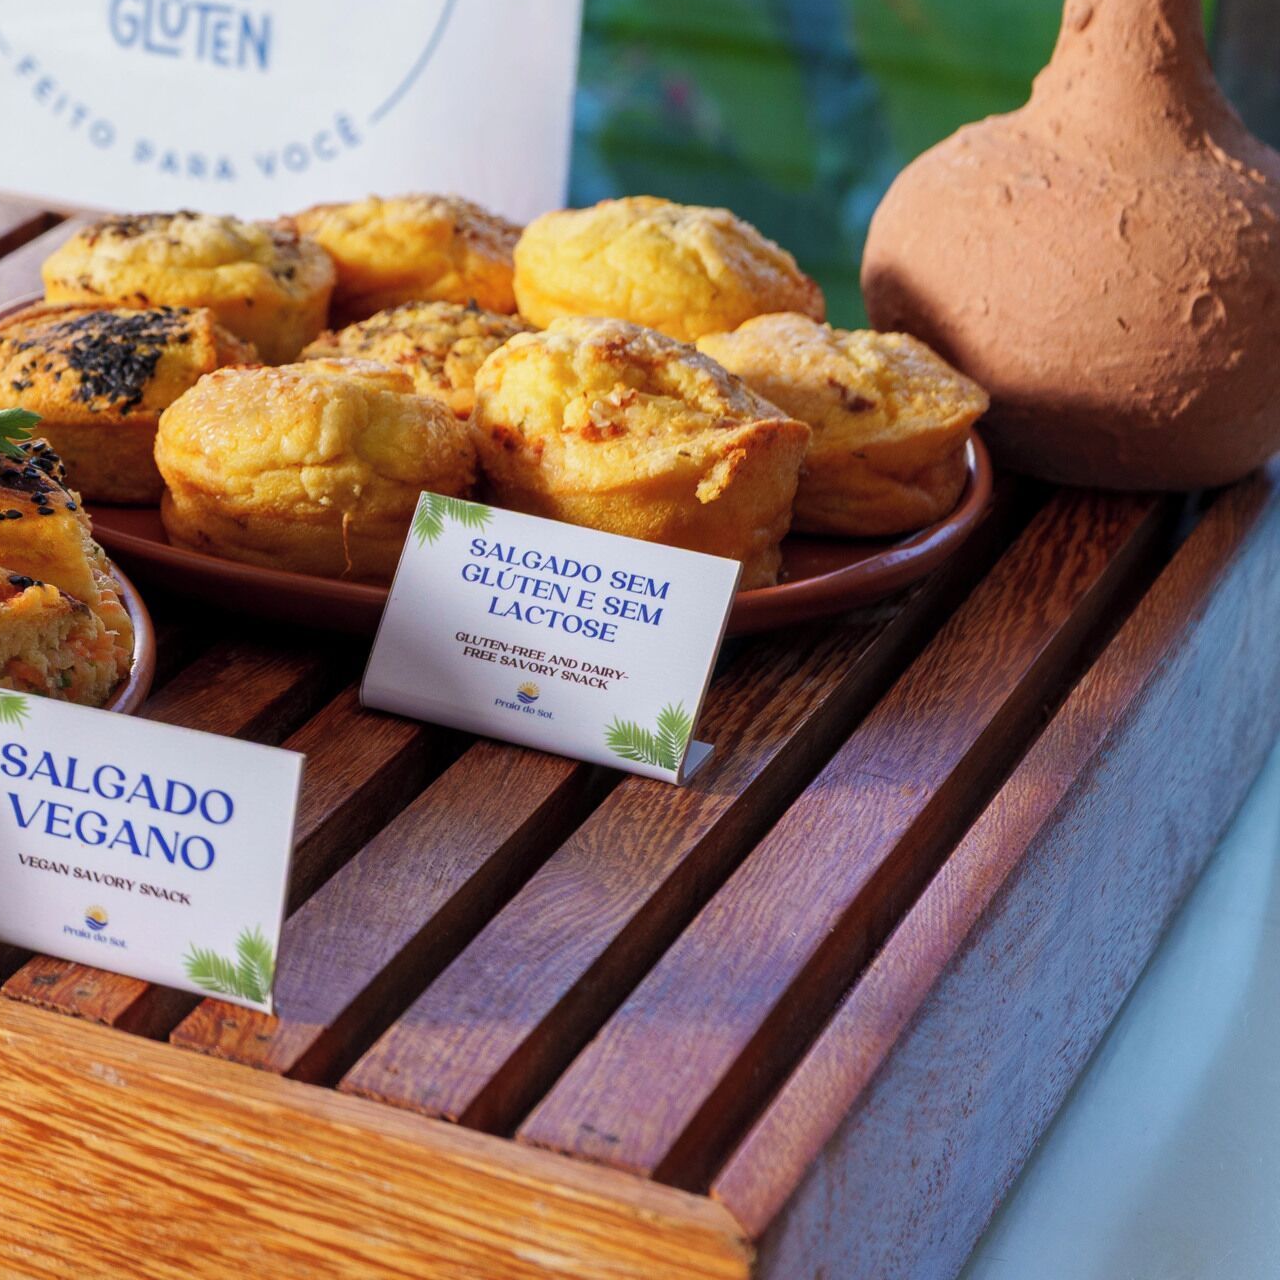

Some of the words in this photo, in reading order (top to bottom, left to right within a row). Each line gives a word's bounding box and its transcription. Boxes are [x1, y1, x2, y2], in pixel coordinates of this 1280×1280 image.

[15, 57, 115, 149] FEITO
[135, 140, 236, 182] PARA
[254, 112, 362, 179] VOCÊ
[461, 563, 570, 604] GLÚTEN
[577, 590, 595, 611] E
[602, 596, 664, 626] SEM
[469, 538, 602, 584] SALGADO
[609, 570, 671, 600] SEM
[487, 596, 619, 643] LACTOSE
[455, 631, 546, 663] GLUTEN-FREE
[548, 653, 579, 670] AND
[581, 660, 630, 681] DAIRY-
[463, 645, 497, 663] FREE
[499, 654, 558, 679] SAVORY
[561, 670, 610, 690] SNACK
[495, 698, 521, 711] Praia
[0, 742, 235, 825] SALGADO
[7, 792, 216, 872] VEGANO
[18, 852, 69, 875] VEGAN
[73, 866, 136, 892] SAVORY
[139, 882, 192, 906] SNACK
